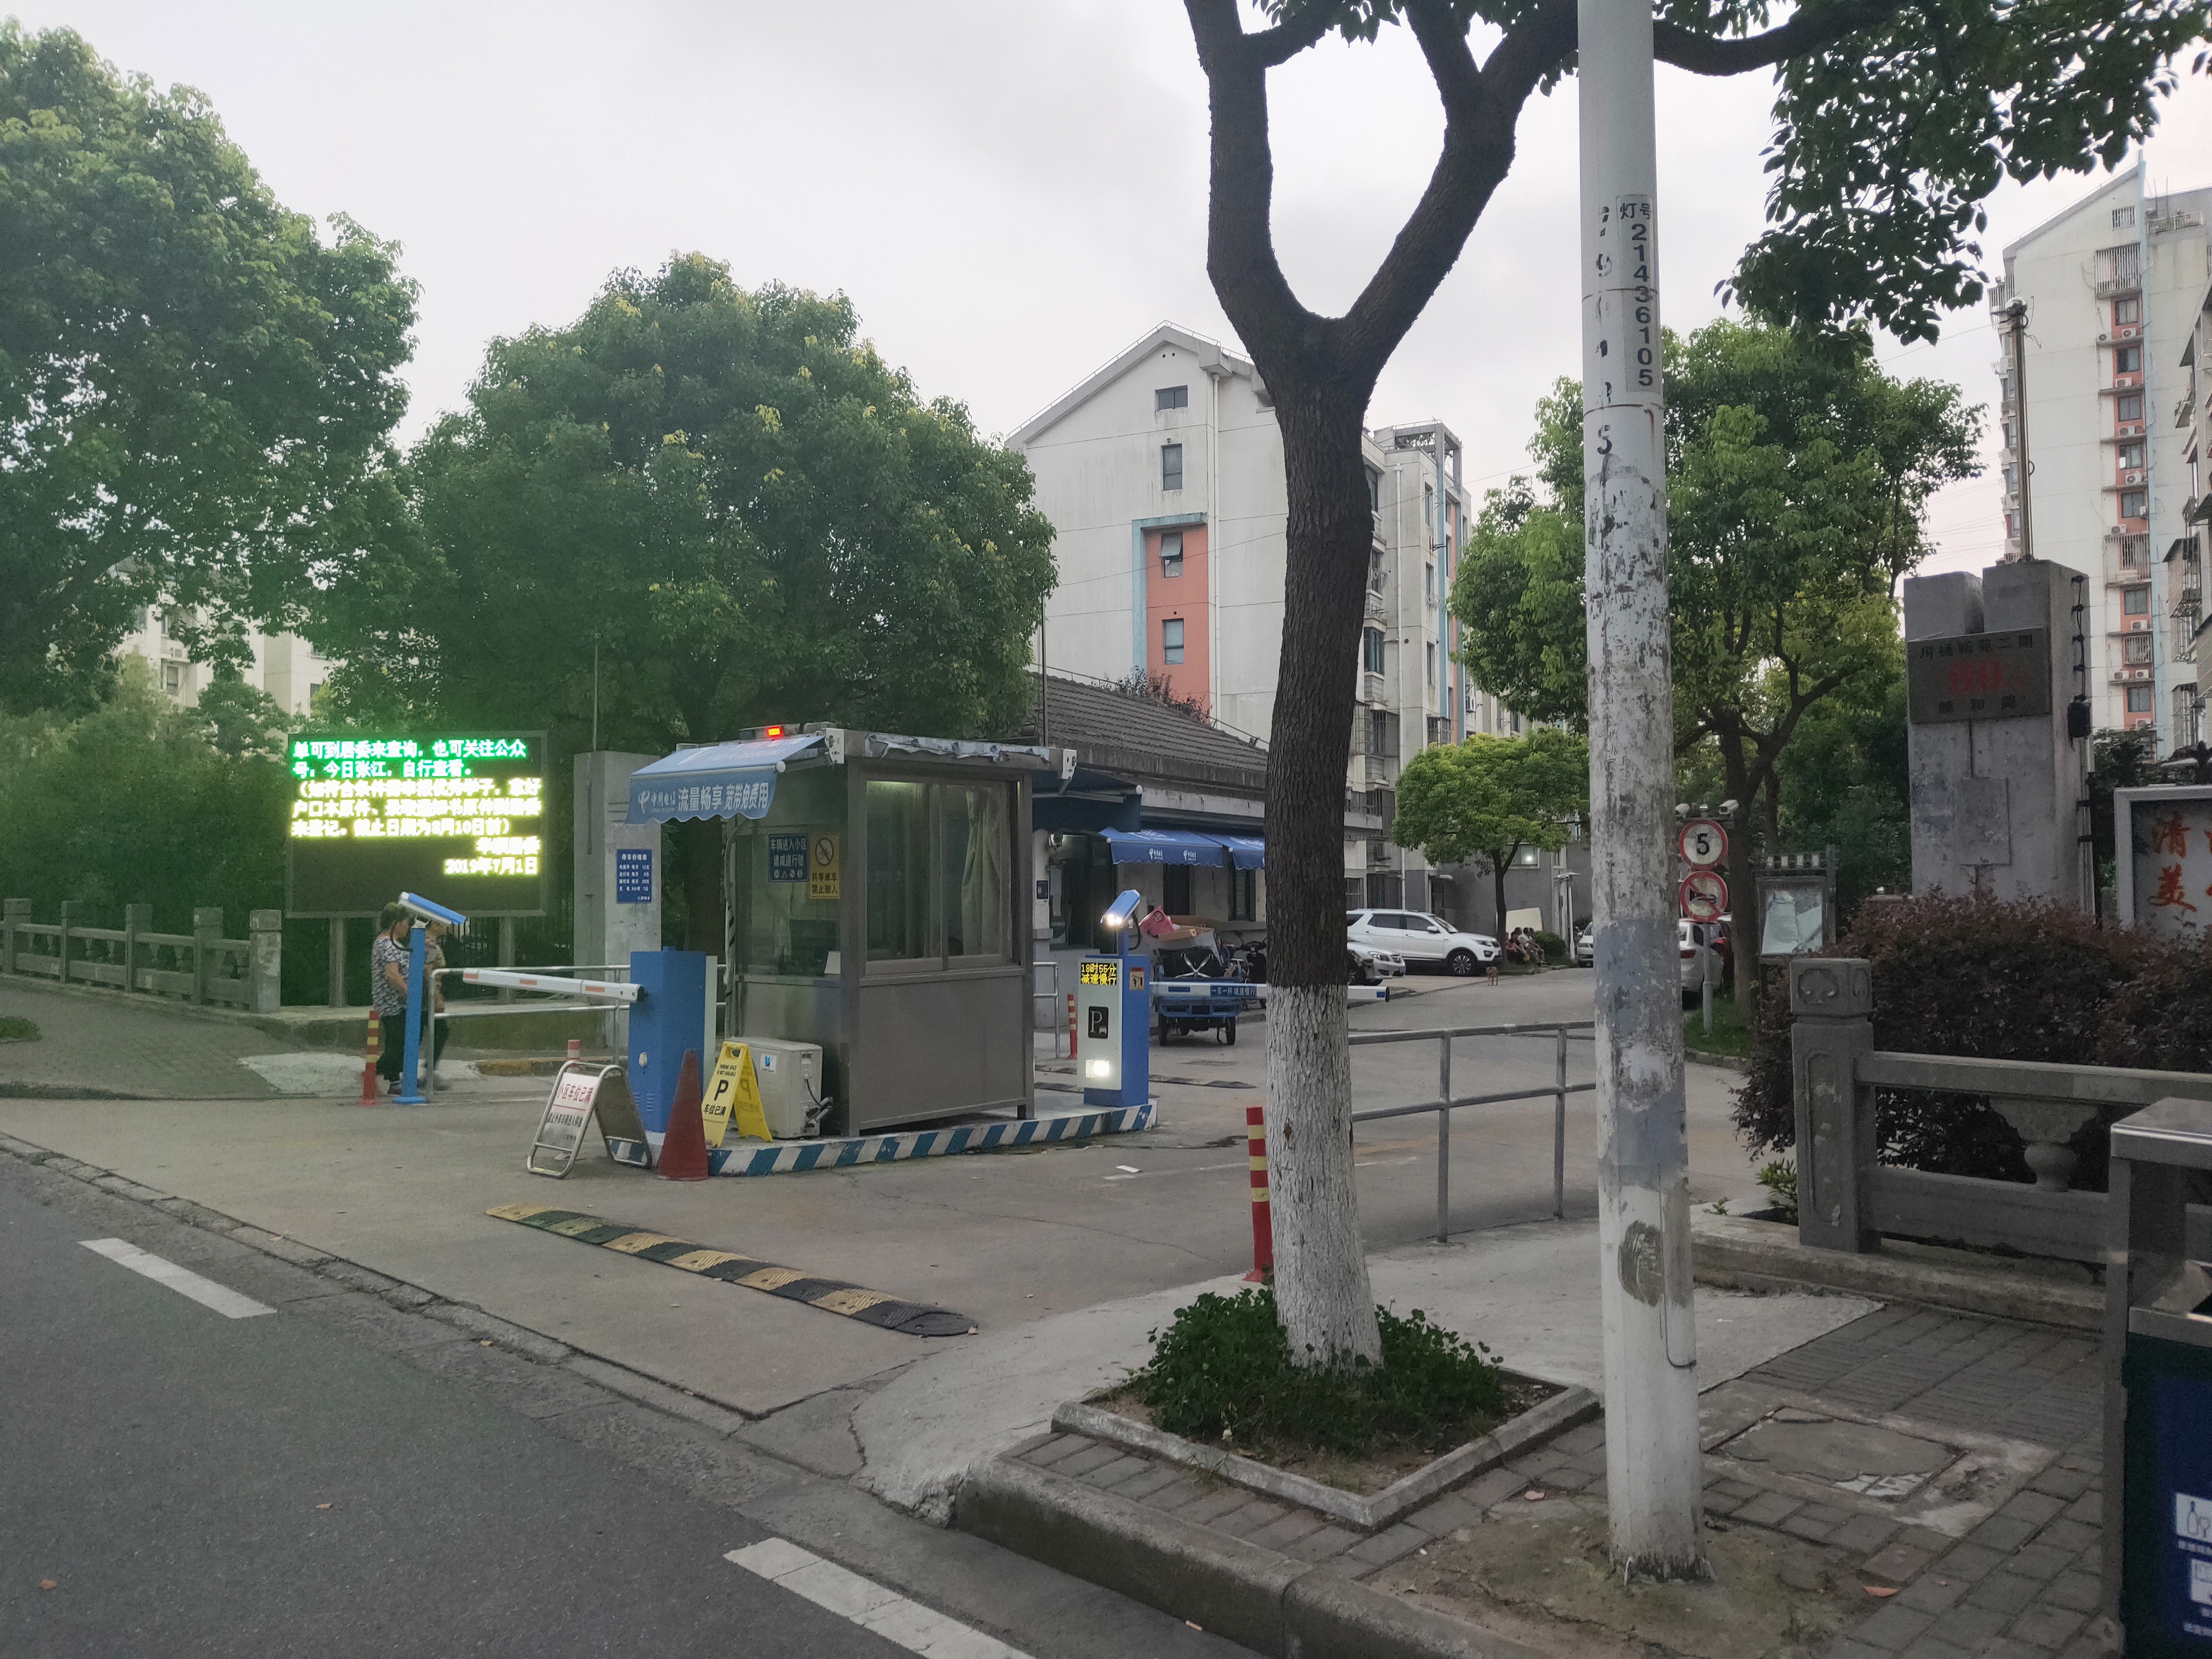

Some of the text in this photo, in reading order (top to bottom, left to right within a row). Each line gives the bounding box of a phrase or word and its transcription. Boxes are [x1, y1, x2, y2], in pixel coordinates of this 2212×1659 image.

[1620, 203, 1652, 220] 灯号
[1631, 224, 1654, 386] 21436105
[677, 784, 723, 811] 流量畅享
[724, 782, 769, 810] 宽带免费用
[770, 838, 806, 851] 车辆进入小区
[1697, 833, 1709, 855] 5
[812, 872, 837, 882] 共享单车
[812, 884, 838, 894] 禁止驶入
[1090, 1010, 1103, 1034] P
[557, 1082, 593, 1104] 小区车位已满
[714, 1079, 729, 1101] P
[703, 1104, 726, 1117] 车位已满
